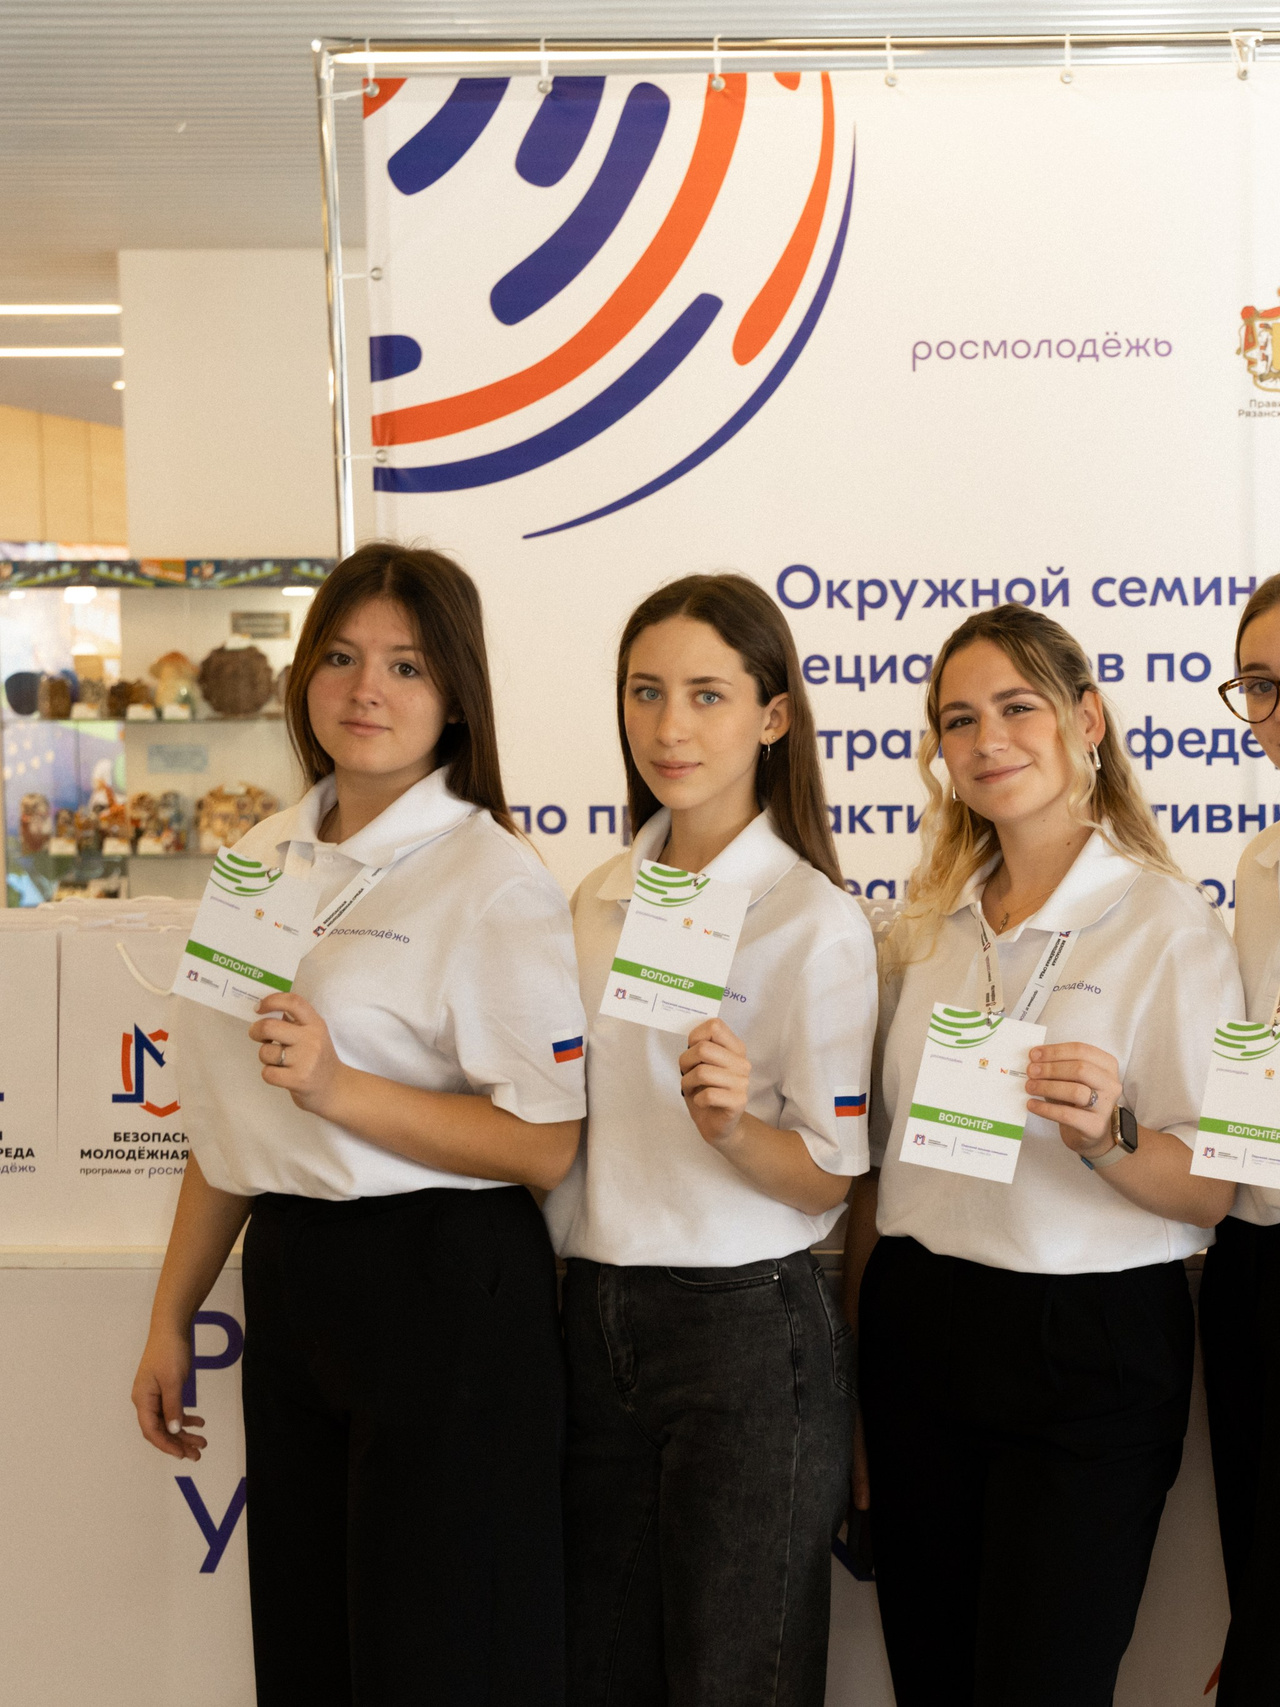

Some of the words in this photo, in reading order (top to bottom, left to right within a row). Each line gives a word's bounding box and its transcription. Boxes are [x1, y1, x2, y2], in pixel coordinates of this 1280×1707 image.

[911, 331, 1173, 372] росмолодёжь
[776, 564, 1070, 621] Окружной
[1147, 652, 1212, 683] по
[328, 928, 411, 944] росмолодёжь
[212, 952, 264, 980] ВОЛОНТЁР
[640, 967, 695, 990] ВОЛОНТЁР
[938, 1111, 994, 1132] ВОЛОНТЁР
[80, 1146, 190, 1161] МОЛОДЁЖНАЯ
[79, 1167, 132, 1176] программа
